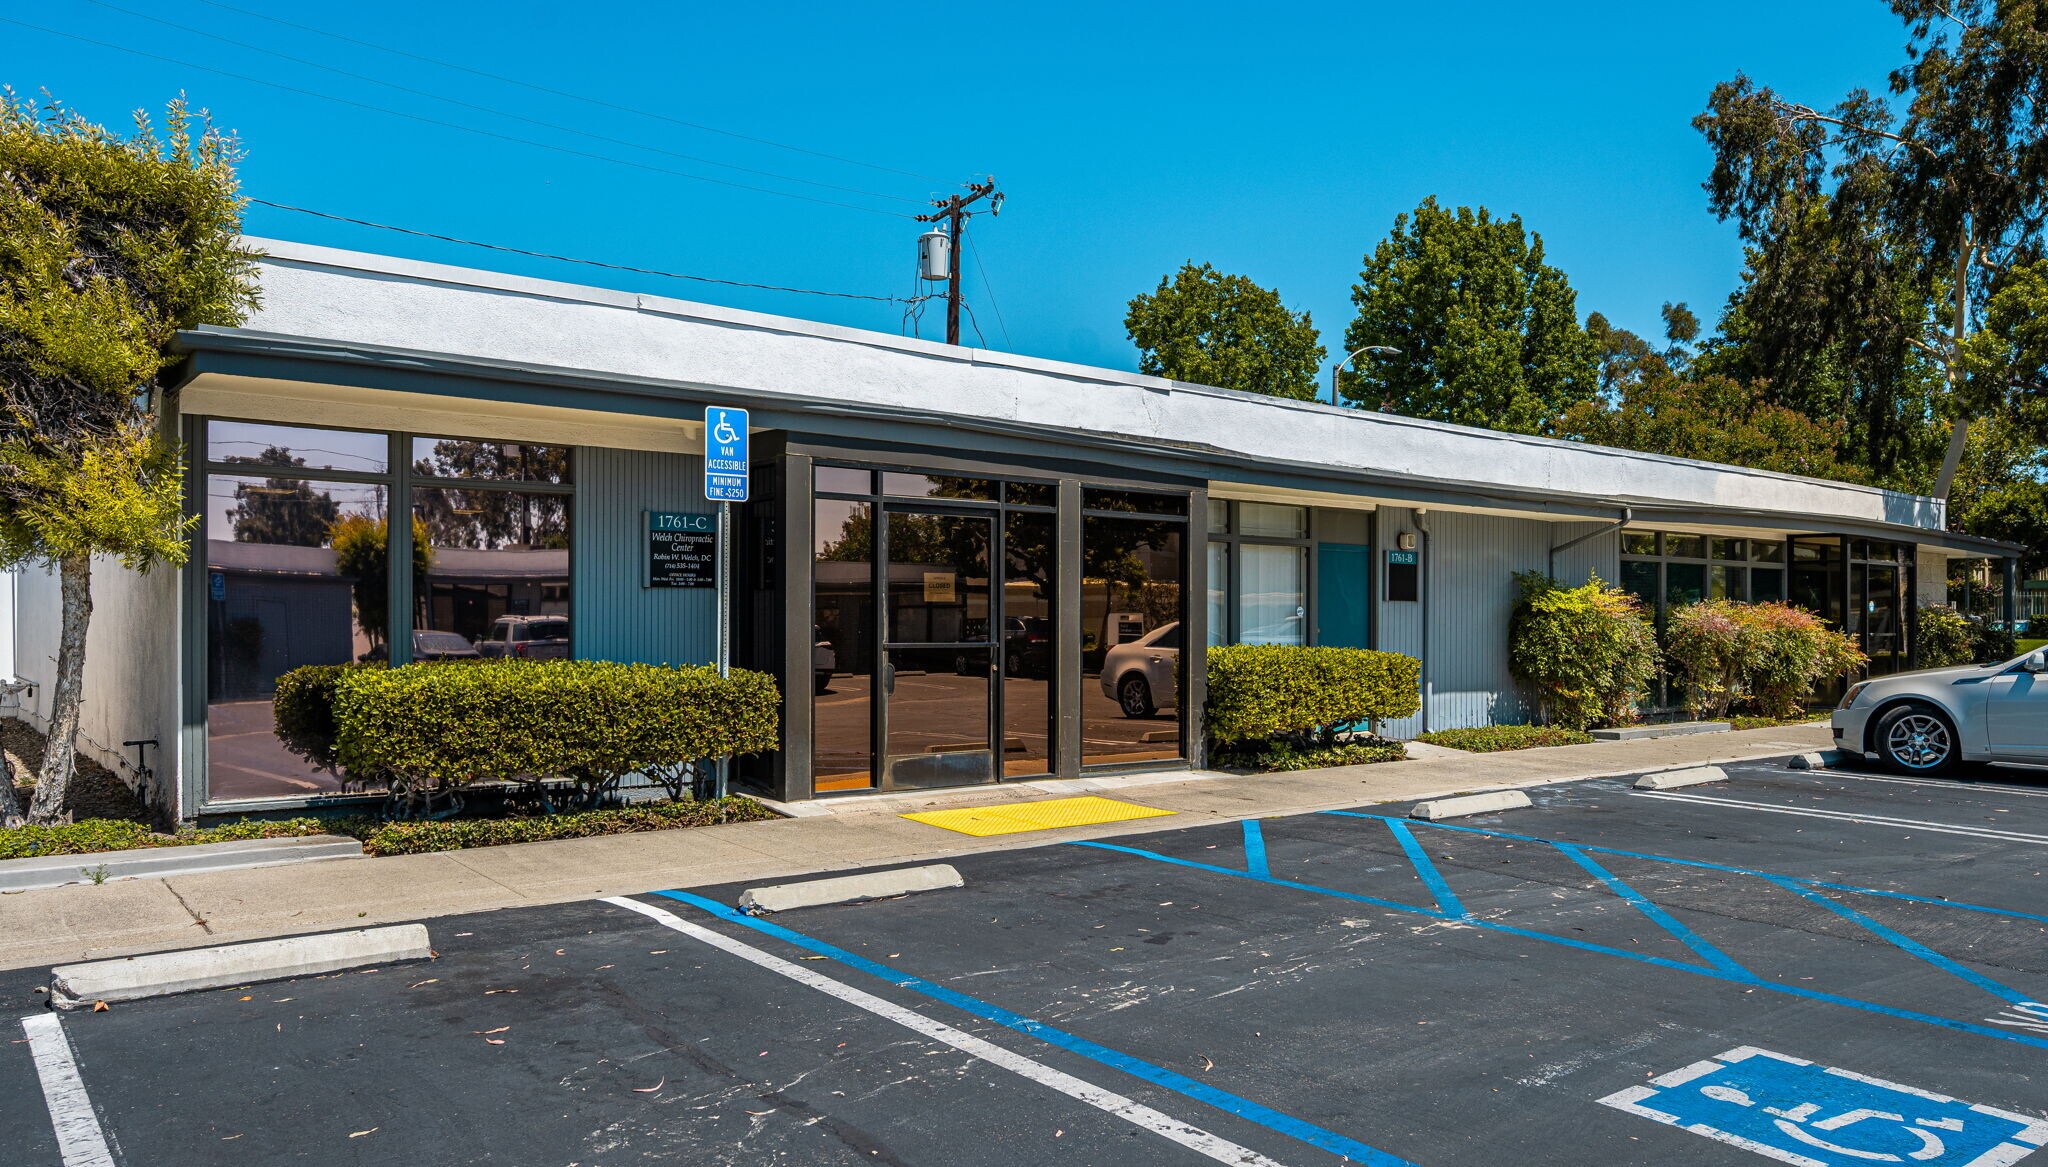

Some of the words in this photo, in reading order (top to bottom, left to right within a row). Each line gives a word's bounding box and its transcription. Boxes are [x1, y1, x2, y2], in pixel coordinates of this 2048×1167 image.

[720, 446, 734, 457] VAN
[708, 459, 746, 471] ACCESSIBLE
[712, 476, 742, 487] MINIMUM
[710, 487, 724, 497] FINE
[658, 515, 707, 530] 1761-C
[652, 532, 672, 542] Welch
[674, 533, 714, 544] Chiropractic
[671, 543, 694, 552] Center
[701, 554, 712, 562] DC
[1391, 553, 1413, 563] 1761-B
